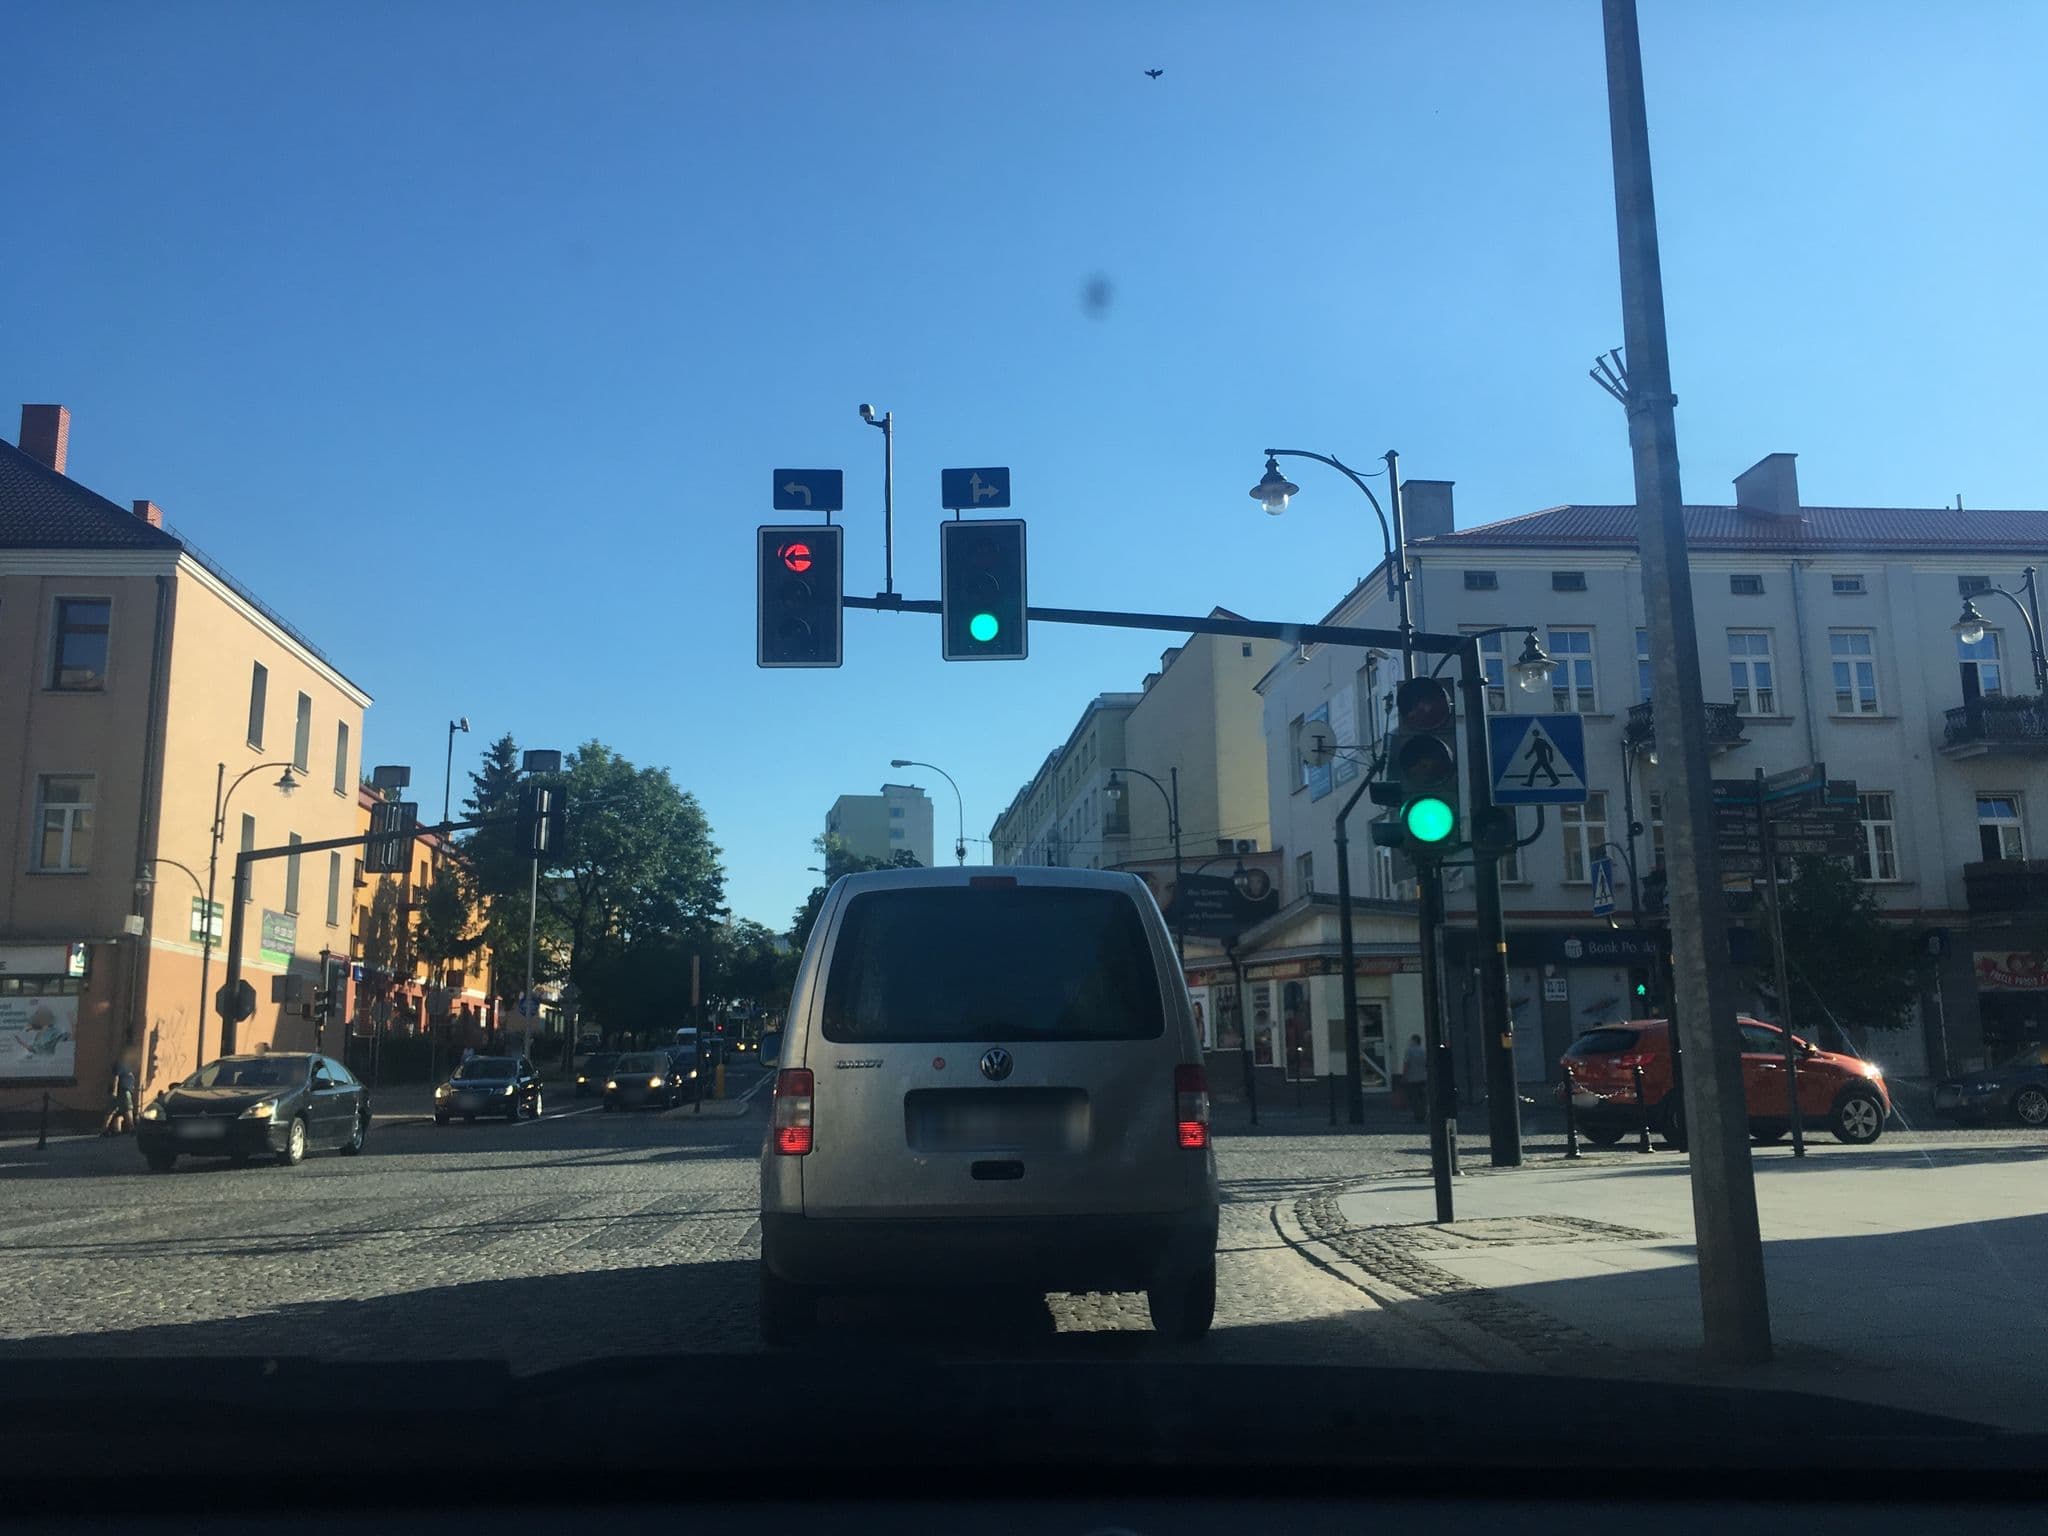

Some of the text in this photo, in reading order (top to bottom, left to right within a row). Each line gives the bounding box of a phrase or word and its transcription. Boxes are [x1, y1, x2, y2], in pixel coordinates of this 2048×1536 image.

[1588, 939, 1618, 953] Bank
[1621, 940, 1656, 953] Poki
[836, 1059, 884, 1070] CADDY
